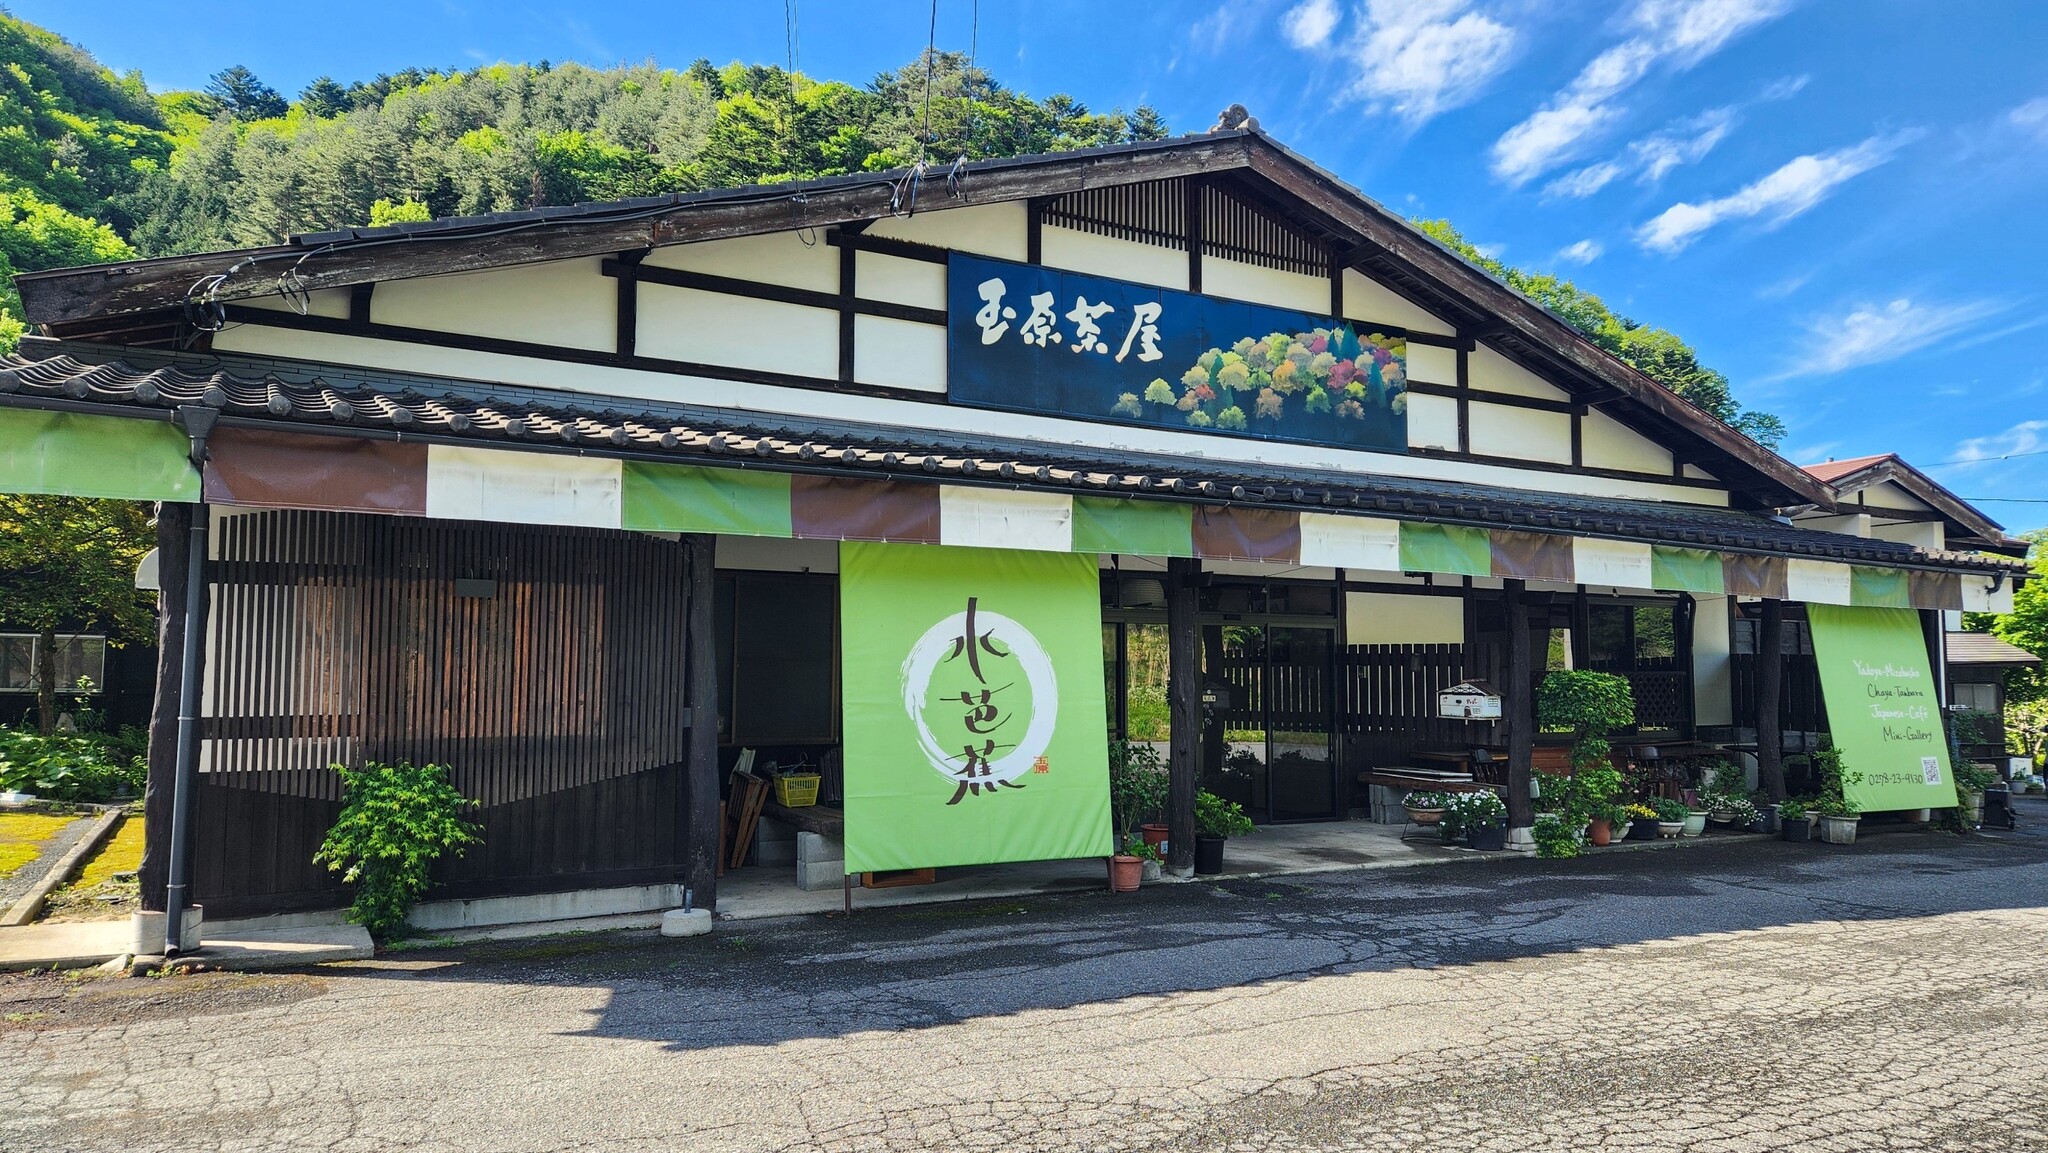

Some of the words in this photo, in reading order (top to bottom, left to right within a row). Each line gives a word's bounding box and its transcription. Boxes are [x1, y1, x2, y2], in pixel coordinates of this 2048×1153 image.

[976, 278, 1163, 363] 玉原茶屋
[940, 597, 1027, 805] 水芭蕉
[1883, 726, 1932, 742] Mini-Gallery
